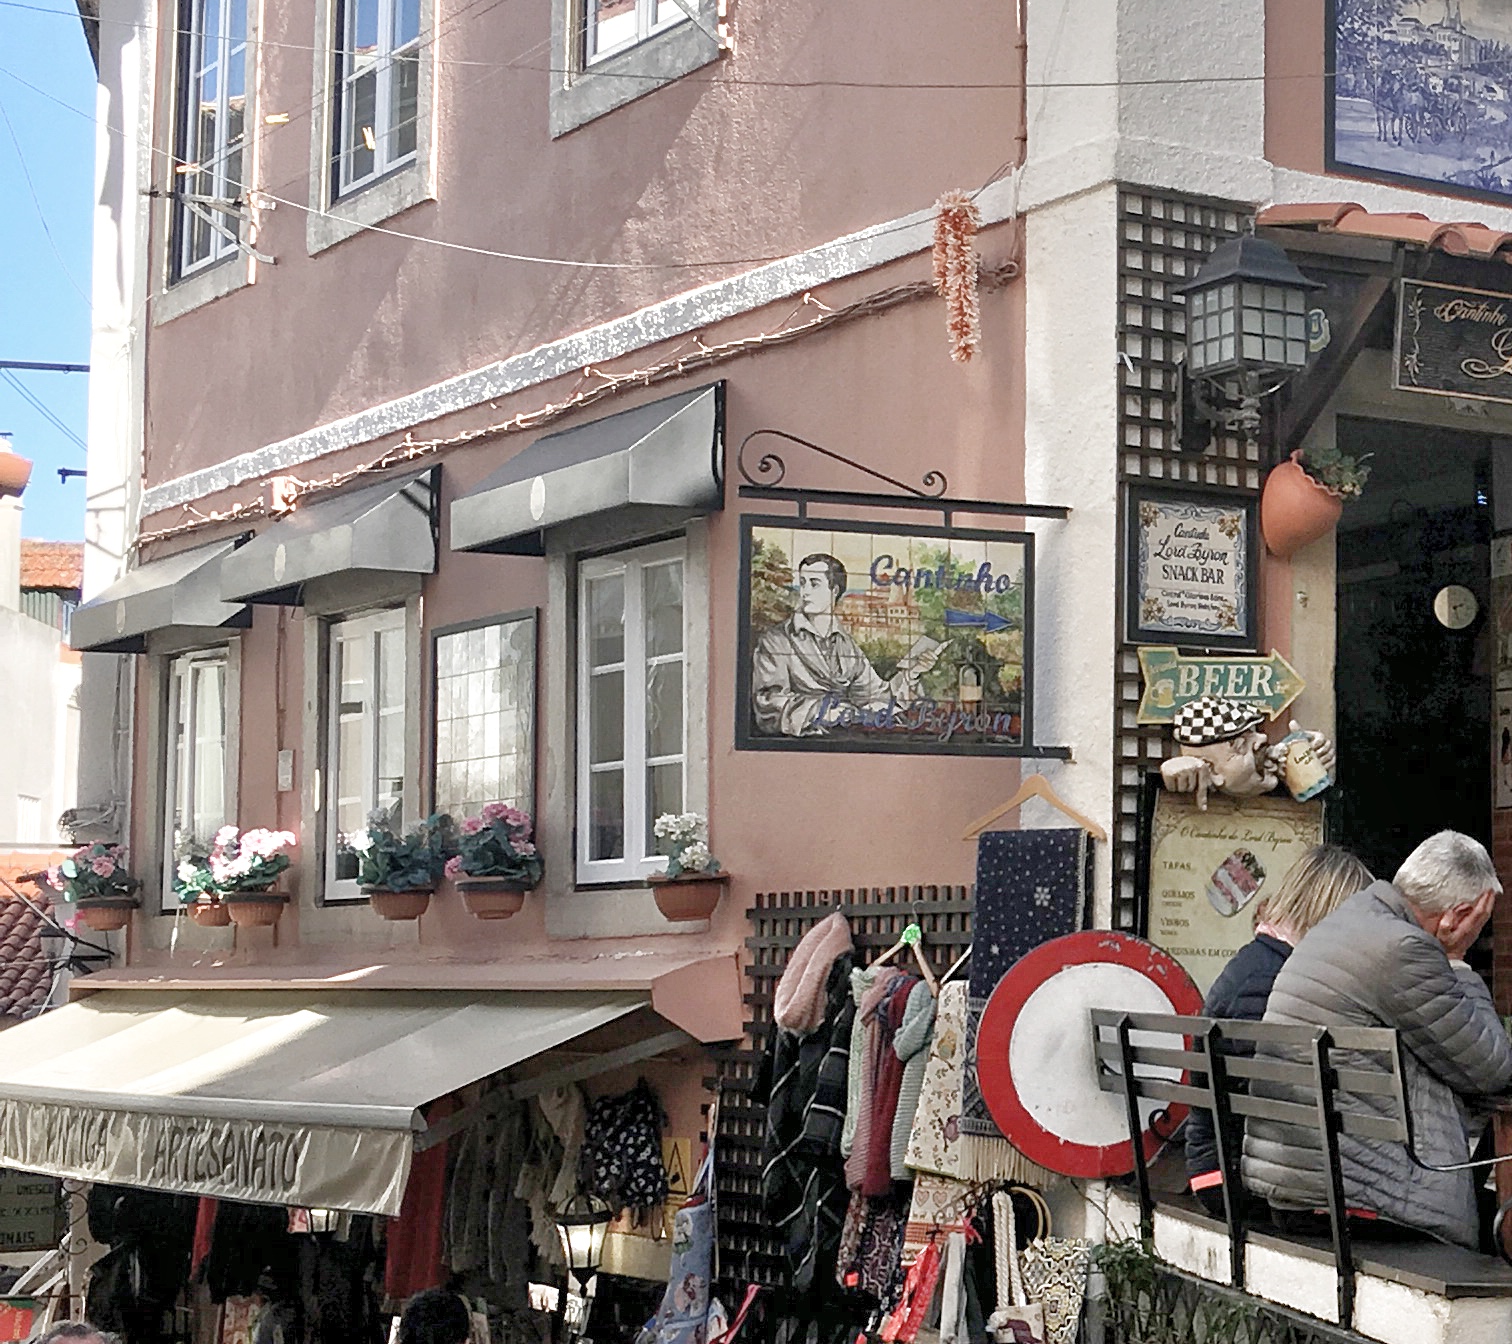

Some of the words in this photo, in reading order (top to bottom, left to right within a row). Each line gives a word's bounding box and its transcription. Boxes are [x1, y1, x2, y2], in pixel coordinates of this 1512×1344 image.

[1433, 299, 1507, 327] Cantinho
[1153, 535, 1187, 560] Lord
[1188, 542, 1230, 565] Byron
[870, 554, 1014, 594] Cantinho
[1162, 564, 1199, 582] SNACK
[1200, 567, 1225, 584] BAR
[1176, 664, 1275, 697] BEER
[811, 692, 897, 730] Lord
[901, 697, 1013, 742] Byron
[1162, 861, 1192, 871] TAPAS
[152, 1126, 300, 1191] ARTESANATO
